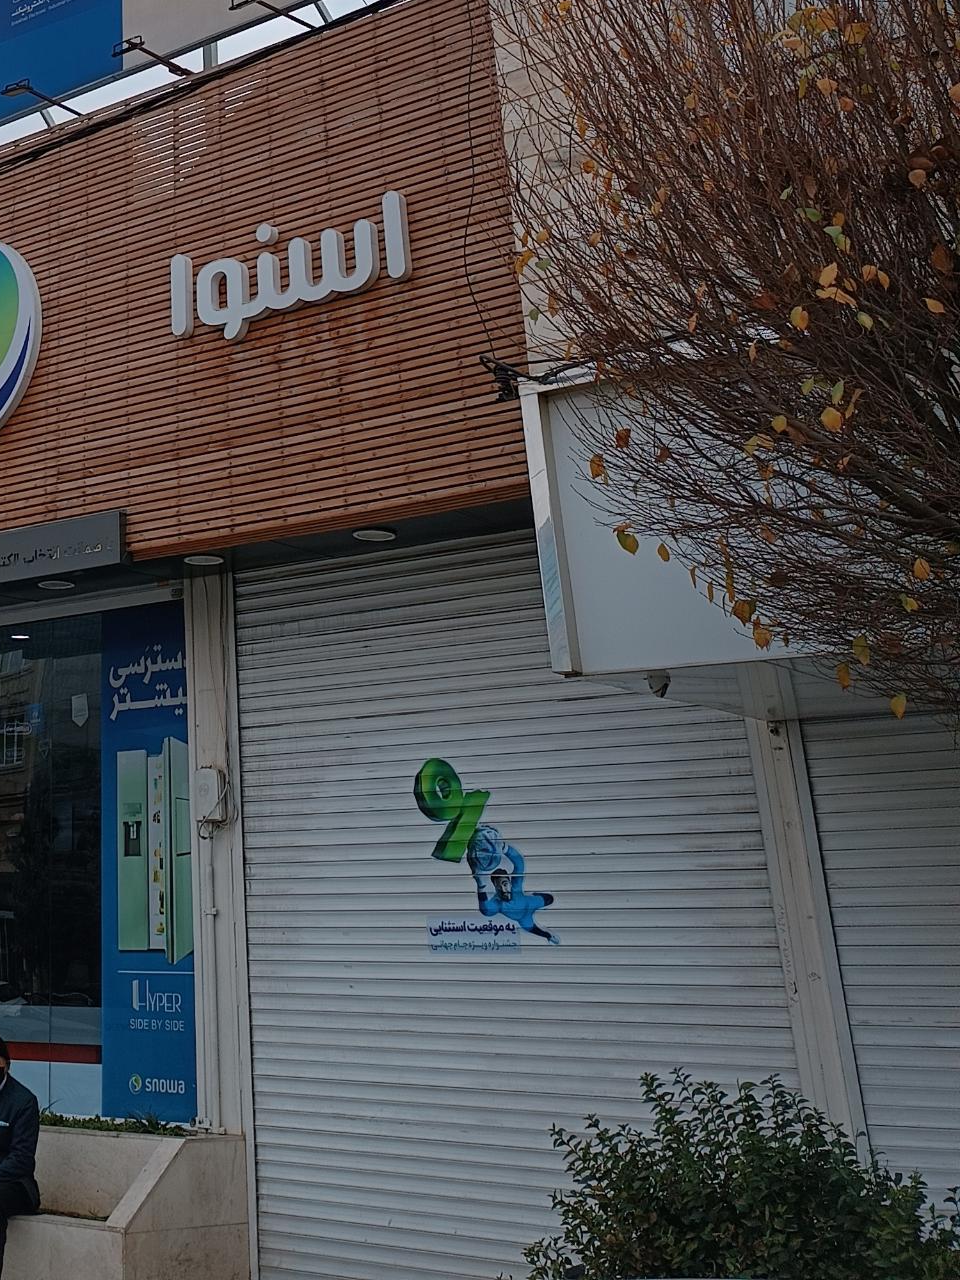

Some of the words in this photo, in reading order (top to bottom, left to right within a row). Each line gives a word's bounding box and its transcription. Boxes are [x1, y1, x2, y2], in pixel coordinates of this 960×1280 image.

[170, 189, 414, 341] اسنوا
[429, 919, 467, 937] استثنایی
[467, 920, 505, 936] موقعیت
[129, 1018, 149, 1030] SIDE
[151, 1018, 162, 1030] BY
[165, 1019, 185, 1032] SIDE
[145, 1077, 186, 1095] snowa
